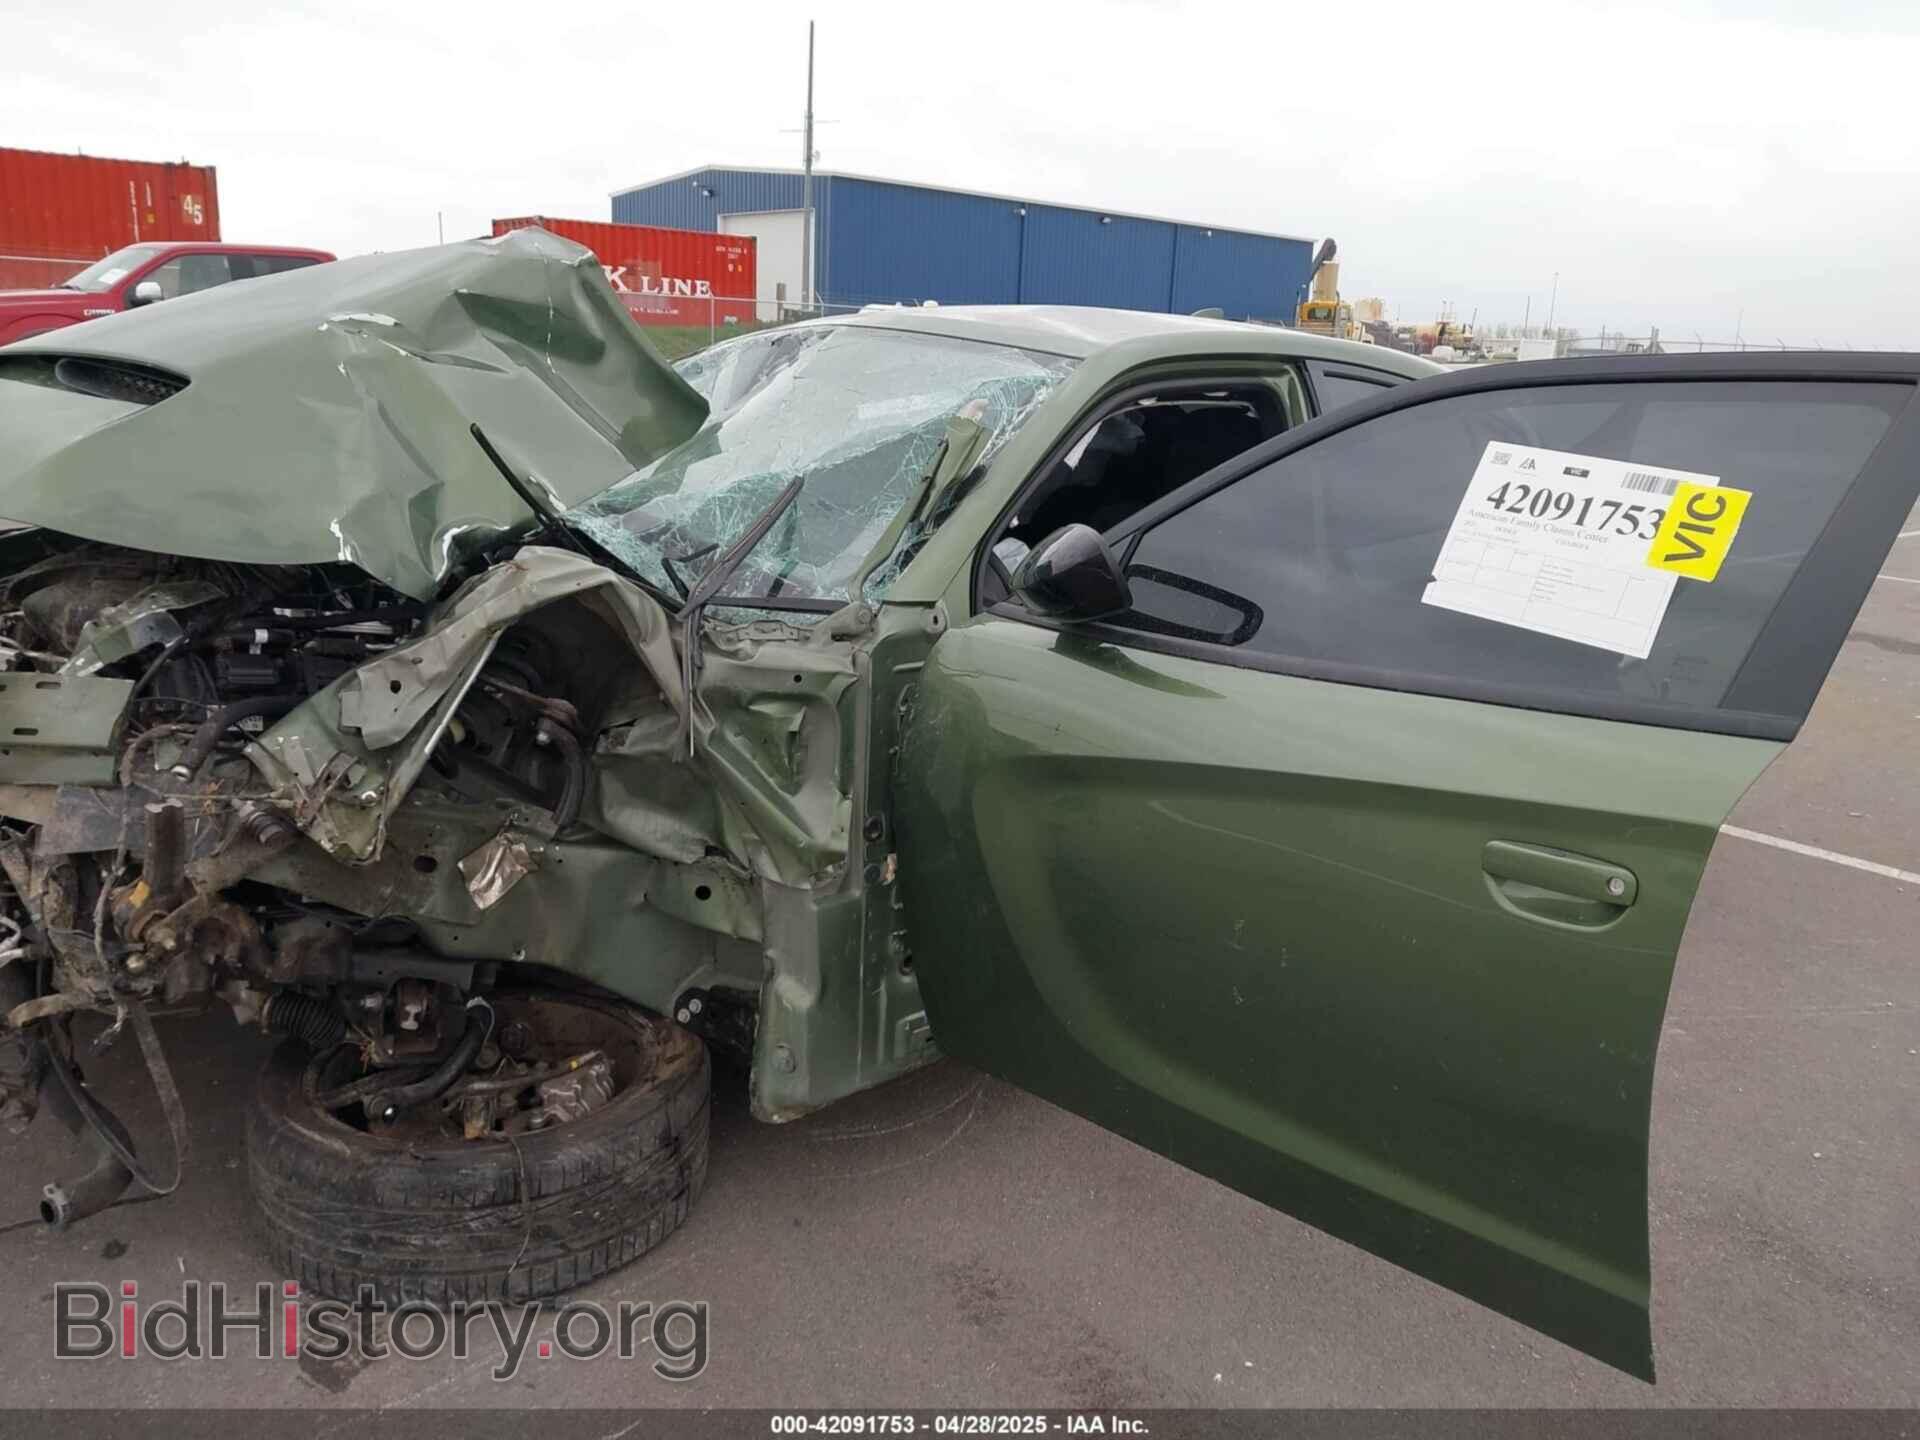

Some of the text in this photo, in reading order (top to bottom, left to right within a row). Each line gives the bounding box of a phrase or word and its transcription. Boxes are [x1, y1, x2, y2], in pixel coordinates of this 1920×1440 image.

[183, 195, 204, 225] 45
[601, 265, 712, 298] K LINE
[1486, 481, 1667, 541] 42091753
[1510, 517, 1541, 532] Family
[1663, 492, 1727, 562] VIC
